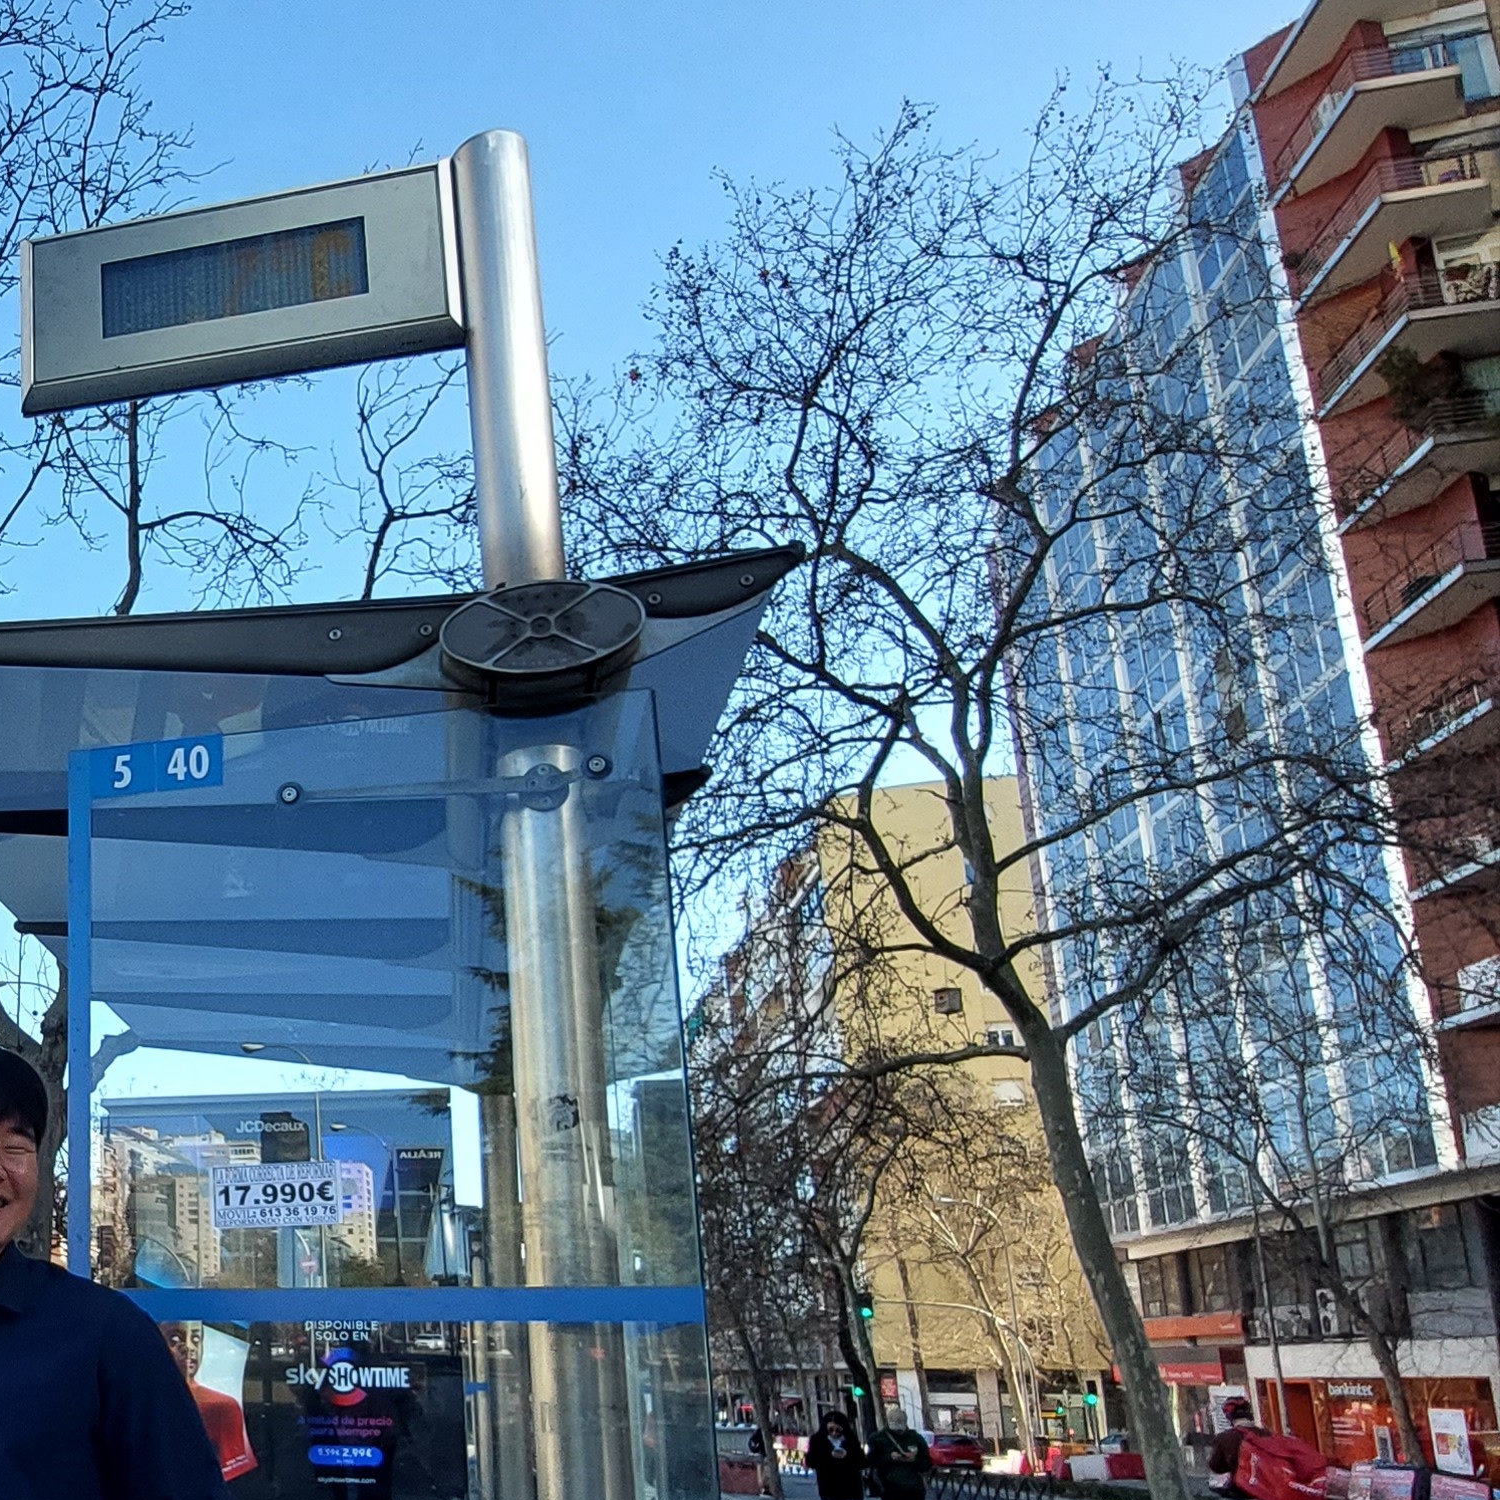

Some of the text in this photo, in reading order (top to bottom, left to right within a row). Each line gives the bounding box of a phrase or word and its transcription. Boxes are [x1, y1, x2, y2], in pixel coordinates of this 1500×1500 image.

[113, 745, 210, 789] 5 40
[235, 1120, 305, 1134] JCDecaux
[218, 1181, 335, 1206] 17.990€
[260, 1207, 282, 1218] 613
[285, 1207, 300, 1217] 36
[304, 1206, 318, 1215] 19
[322, 1205, 337, 1215] 76
[304, 1320, 379, 1331] DISPONIBLE
[315, 1331, 369, 1341] SOLO EN
[357, 1416, 393, 1426] precio
